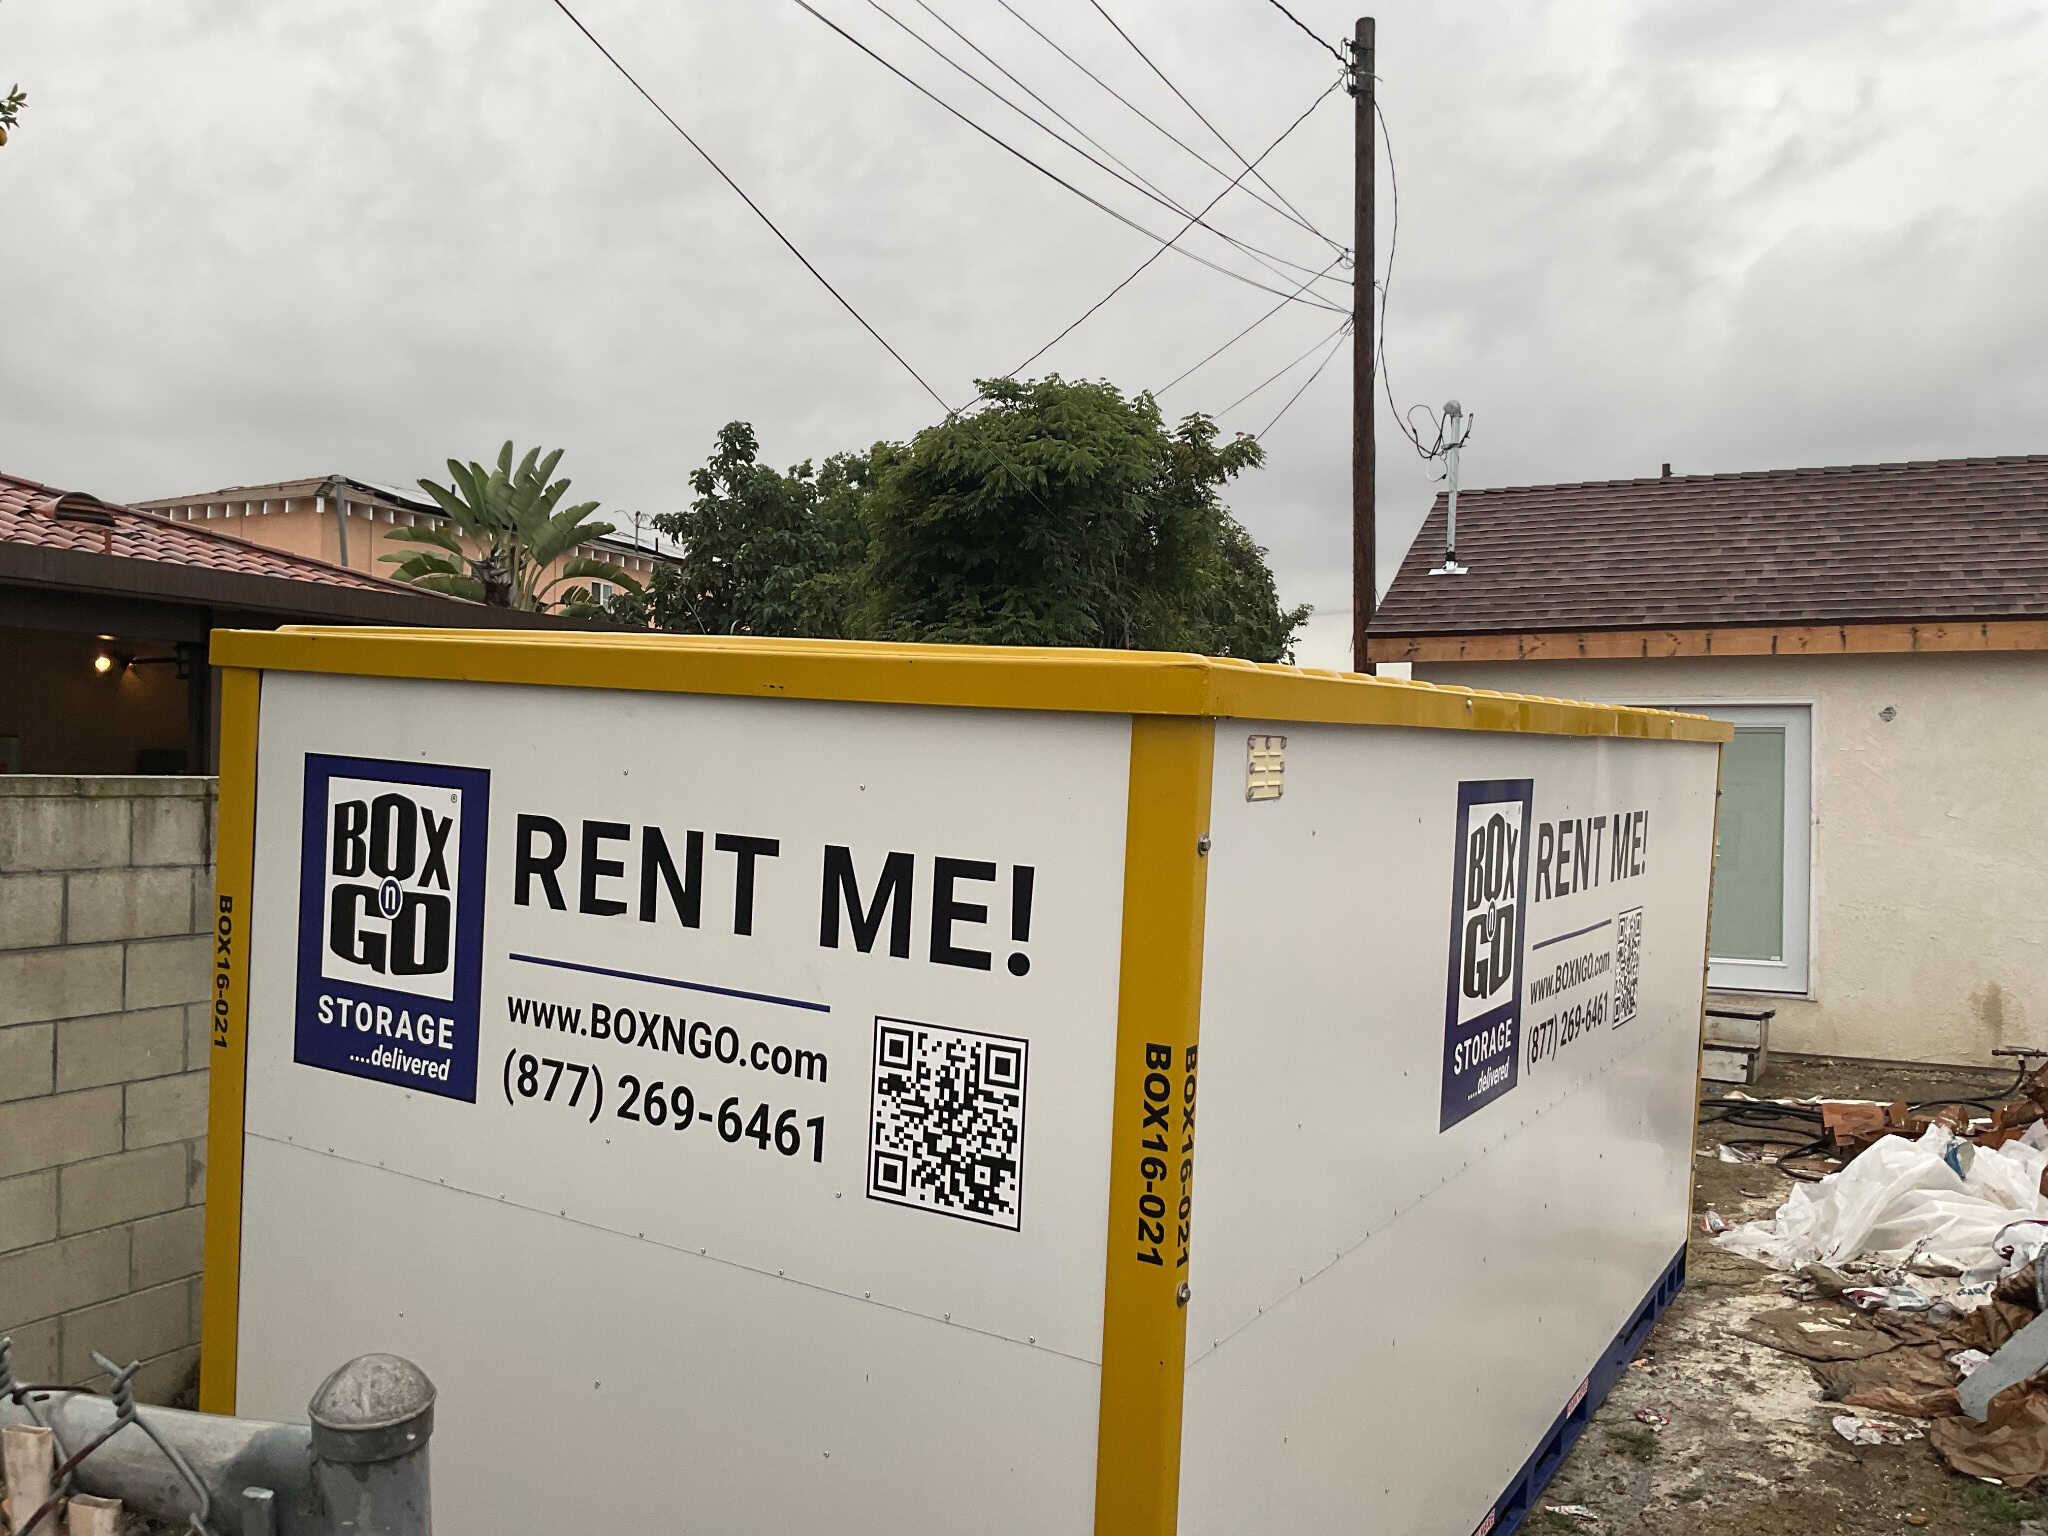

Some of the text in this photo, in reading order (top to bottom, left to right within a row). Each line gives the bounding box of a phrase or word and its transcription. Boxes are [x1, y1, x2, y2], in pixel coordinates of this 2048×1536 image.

[332, 793, 454, 891] BOX
[1467, 813, 1519, 912] BOX
[1534, 810, 1649, 903] RENT ME!
[330, 883, 451, 976] GO
[513, 813, 1035, 977] RENT ME!
[203, 894, 233, 1049] BOX16-021
[1463, 904, 1514, 999] GO
[1530, 951, 1610, 1006] www.BOXNGO.com
[317, 994, 455, 1050] STORAGE
[507, 995, 829, 1083] www.BOXNGO.com
[1453, 1017, 1513, 1076] STORAGE
[1527, 990, 1609, 1076] (877) 269-6461
[503, 1048, 826, 1163] (877) 269-6461
[1136, 1042, 1172, 1268] BOX16-021
[1175, 1043, 1198, 1269] BOX16-021
